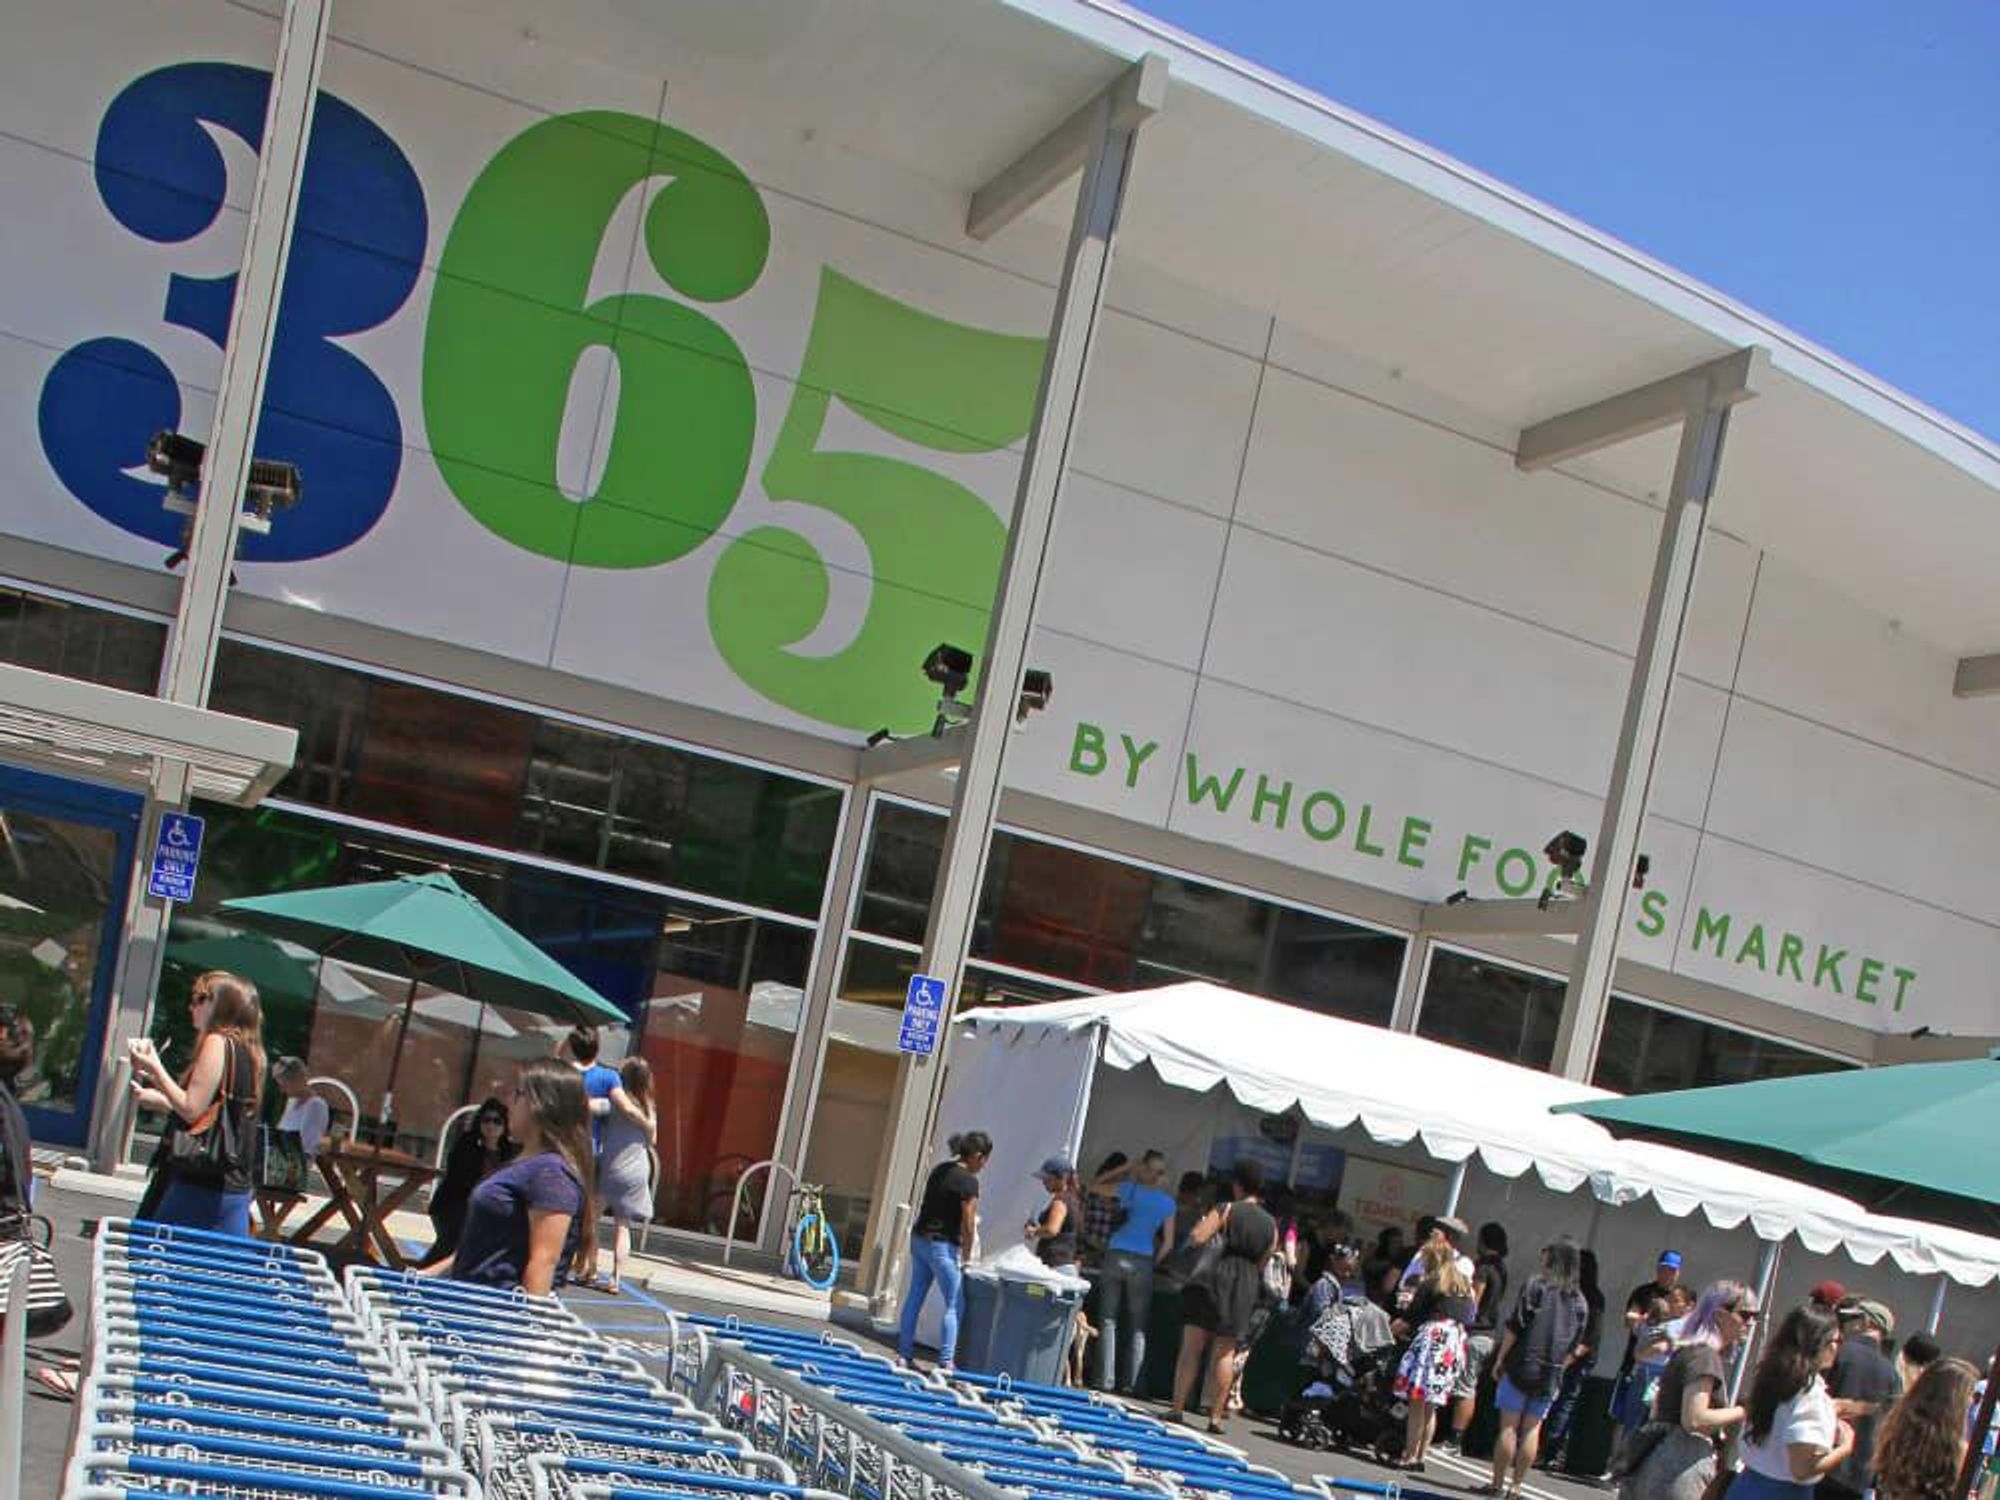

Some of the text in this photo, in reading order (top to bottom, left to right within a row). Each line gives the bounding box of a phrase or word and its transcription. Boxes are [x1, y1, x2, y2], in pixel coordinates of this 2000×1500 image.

[37, 61, 1050, 734] 365
[1070, 722, 1159, 788] BY
[1185, 753, 1432, 869] WHOLE
[1691, 907, 1917, 1012] MARKET
